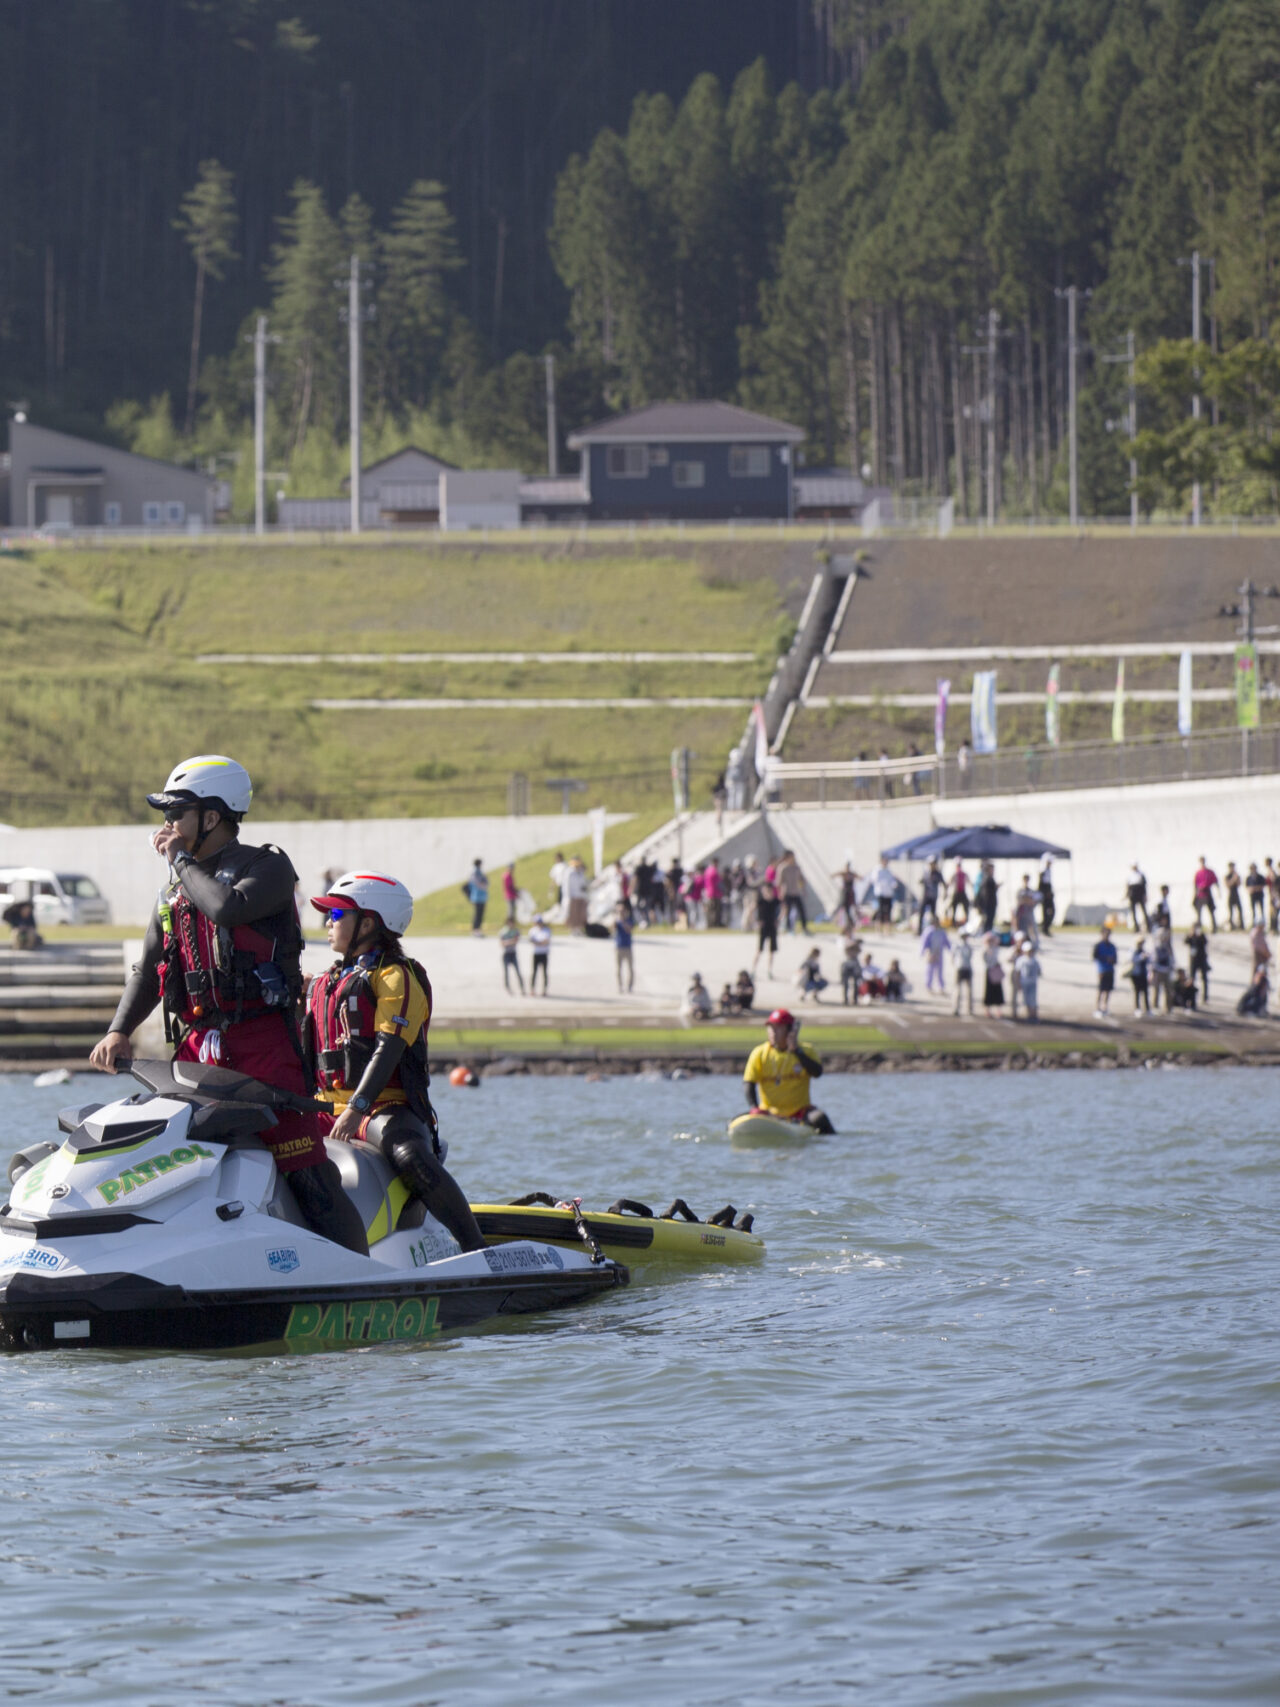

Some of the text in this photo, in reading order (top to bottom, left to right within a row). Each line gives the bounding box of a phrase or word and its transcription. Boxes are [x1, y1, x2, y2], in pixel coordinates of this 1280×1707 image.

[278, 1136, 314, 1153] PATROL
[96, 1144, 215, 1205] PATROL
[25, 1248, 59, 1267] BIRD
[268, 1249, 297, 1265] SEA BIRD
[284, 1297, 442, 1340] PATROL
